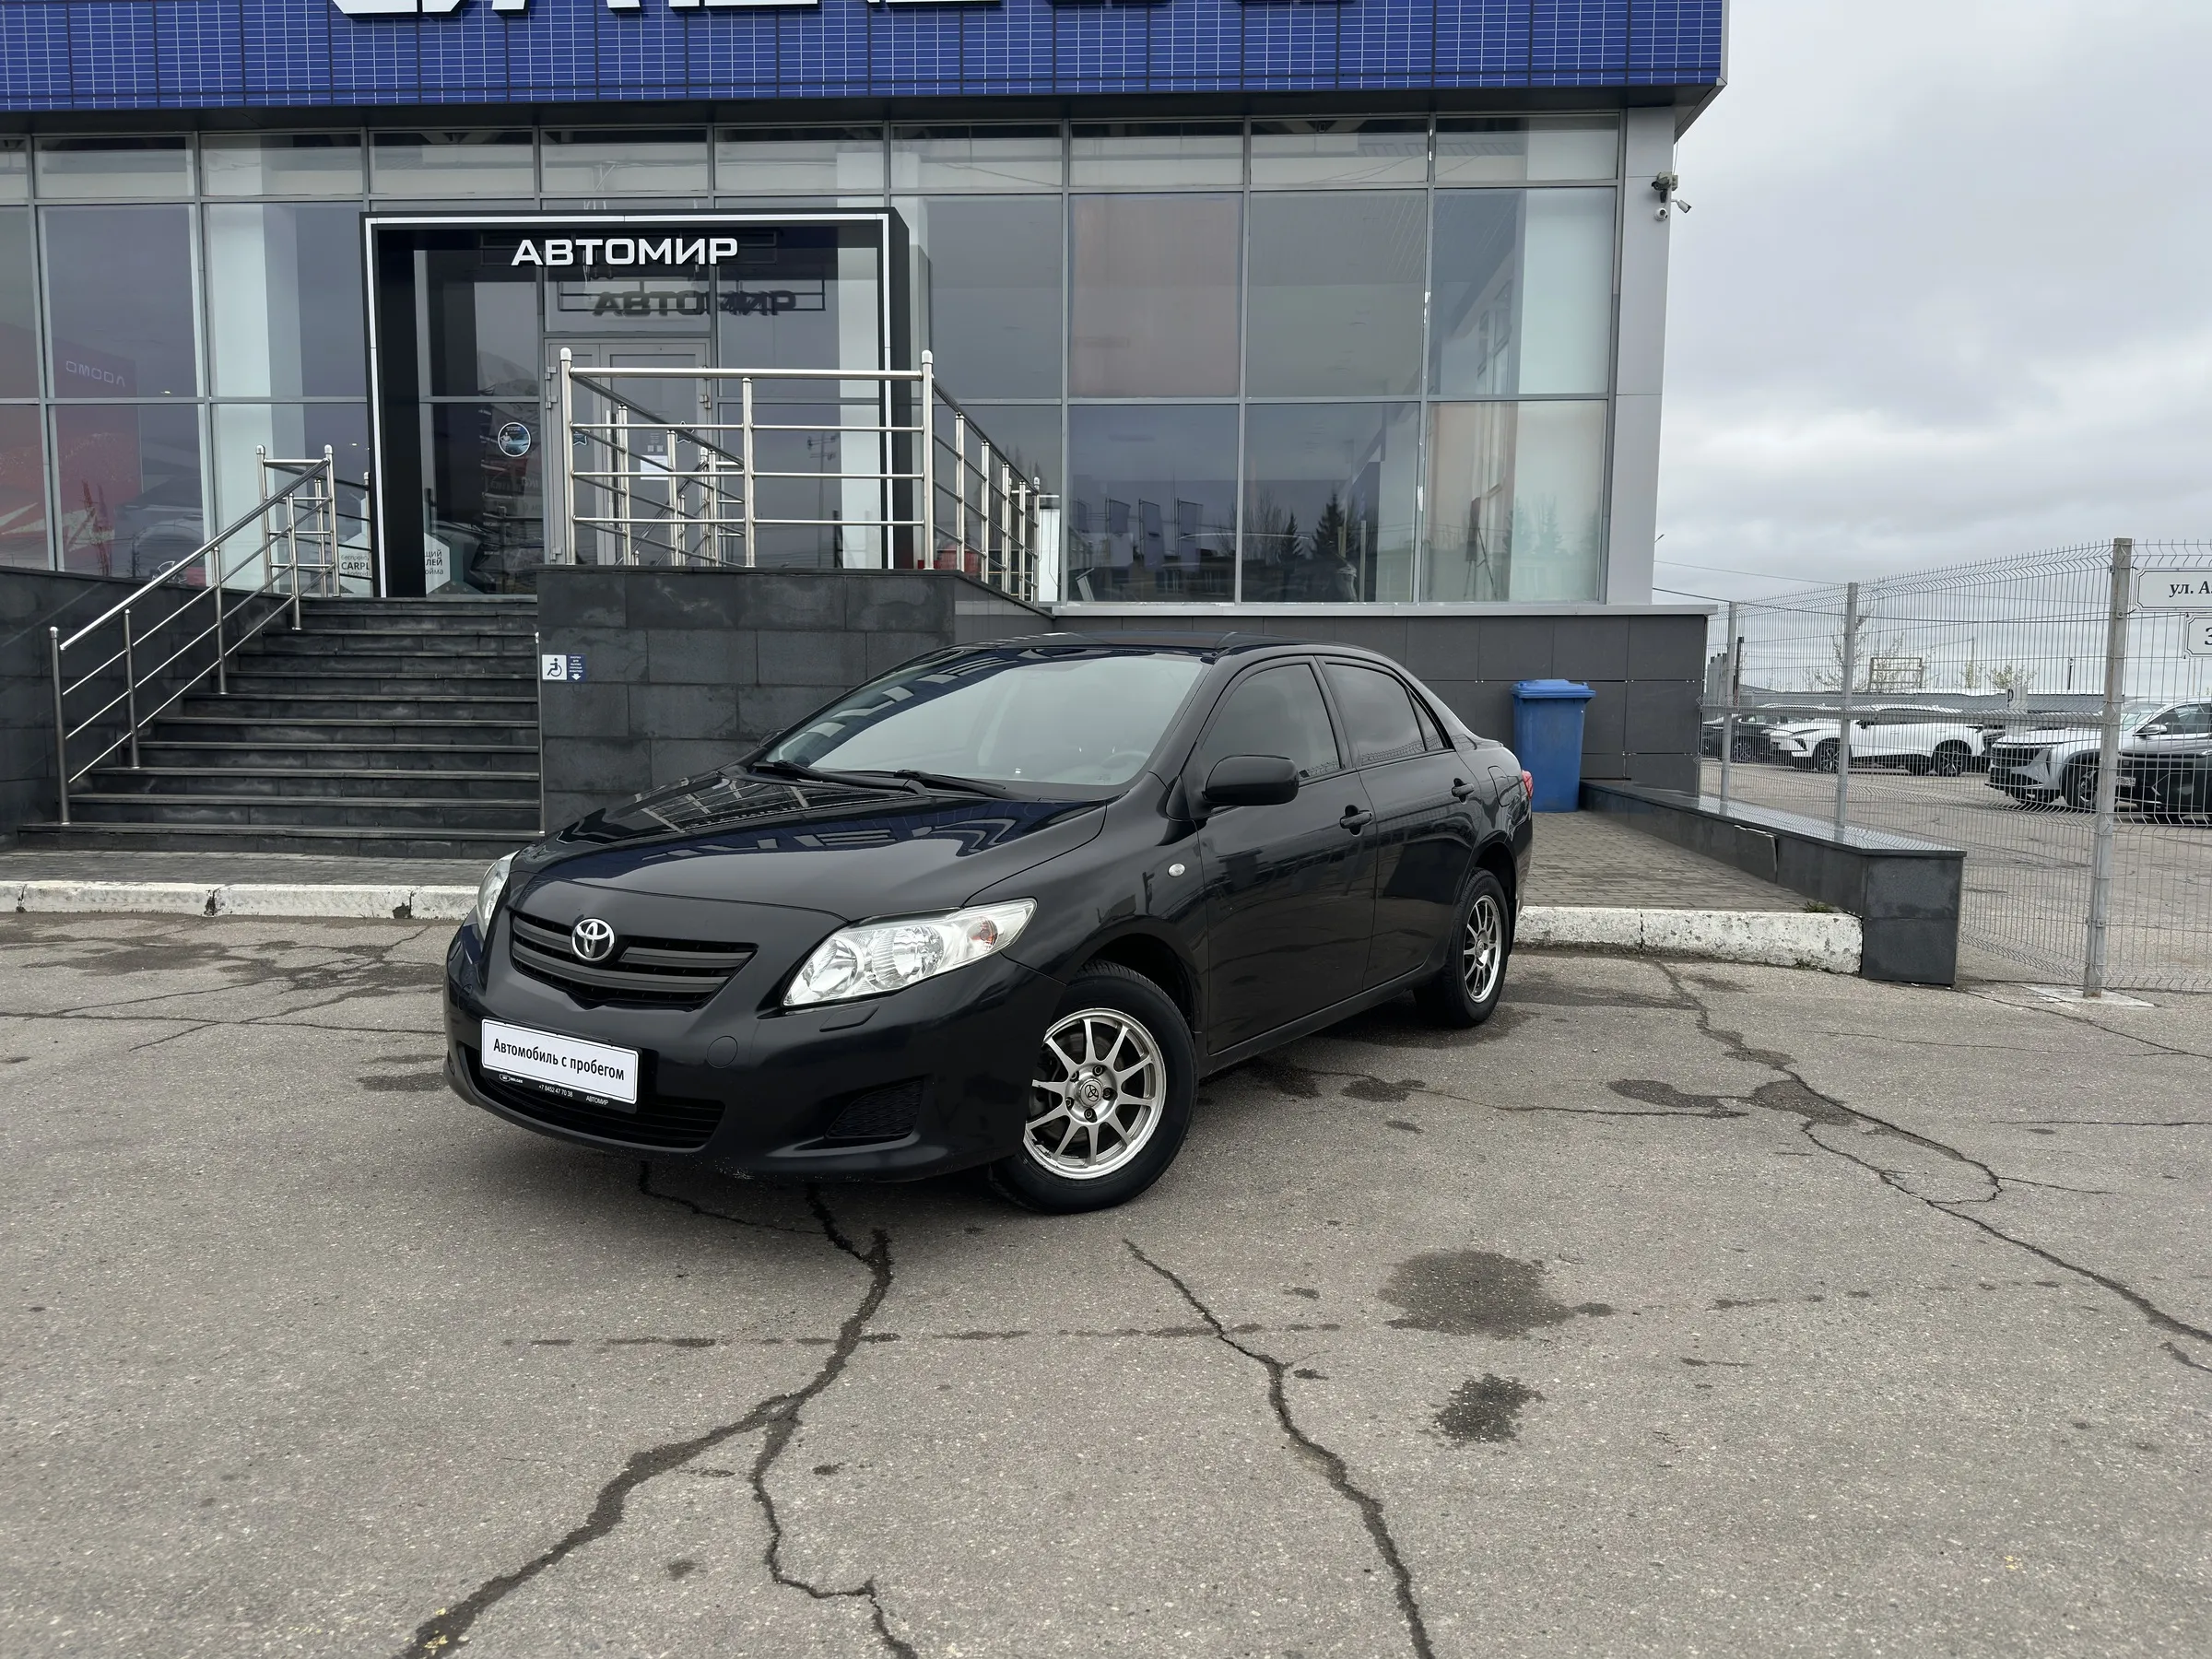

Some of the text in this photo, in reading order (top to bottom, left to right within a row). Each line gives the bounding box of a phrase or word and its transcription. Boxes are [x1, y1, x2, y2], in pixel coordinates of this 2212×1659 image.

[511, 238, 738, 266] АВТОМИР
[2169, 581, 2212, 598] ул. А
[493, 1038, 625, 1081] Автомобиль с пробегом
[585, 1095, 609, 1106] АВТОМИР
